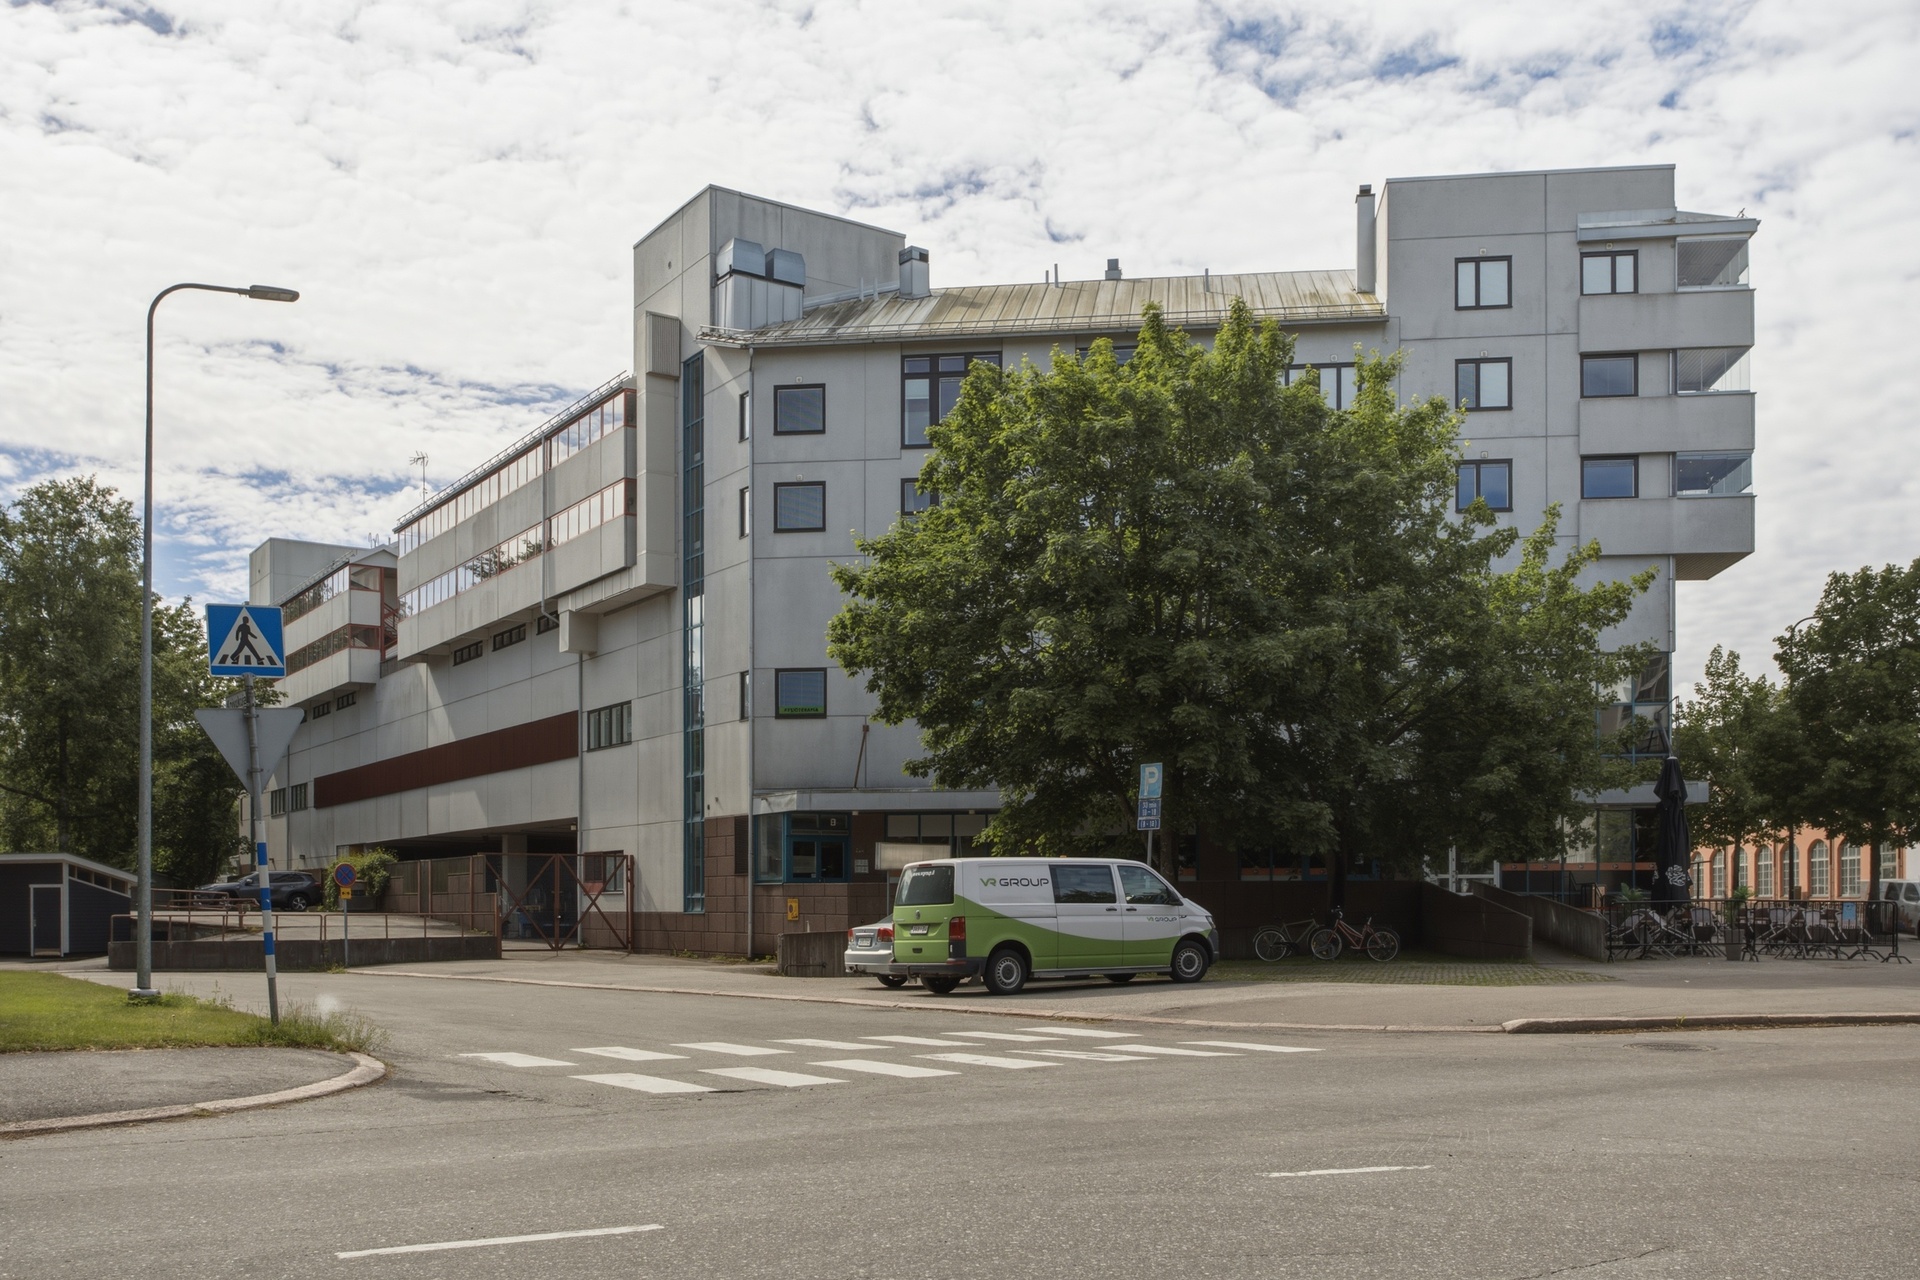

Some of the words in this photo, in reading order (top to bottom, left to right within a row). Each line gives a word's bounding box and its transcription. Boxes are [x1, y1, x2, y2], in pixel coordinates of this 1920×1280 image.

[1144, 767, 1159, 796] P
[979, 878, 997, 887] VR
[999, 878, 1050, 887] GROUP
